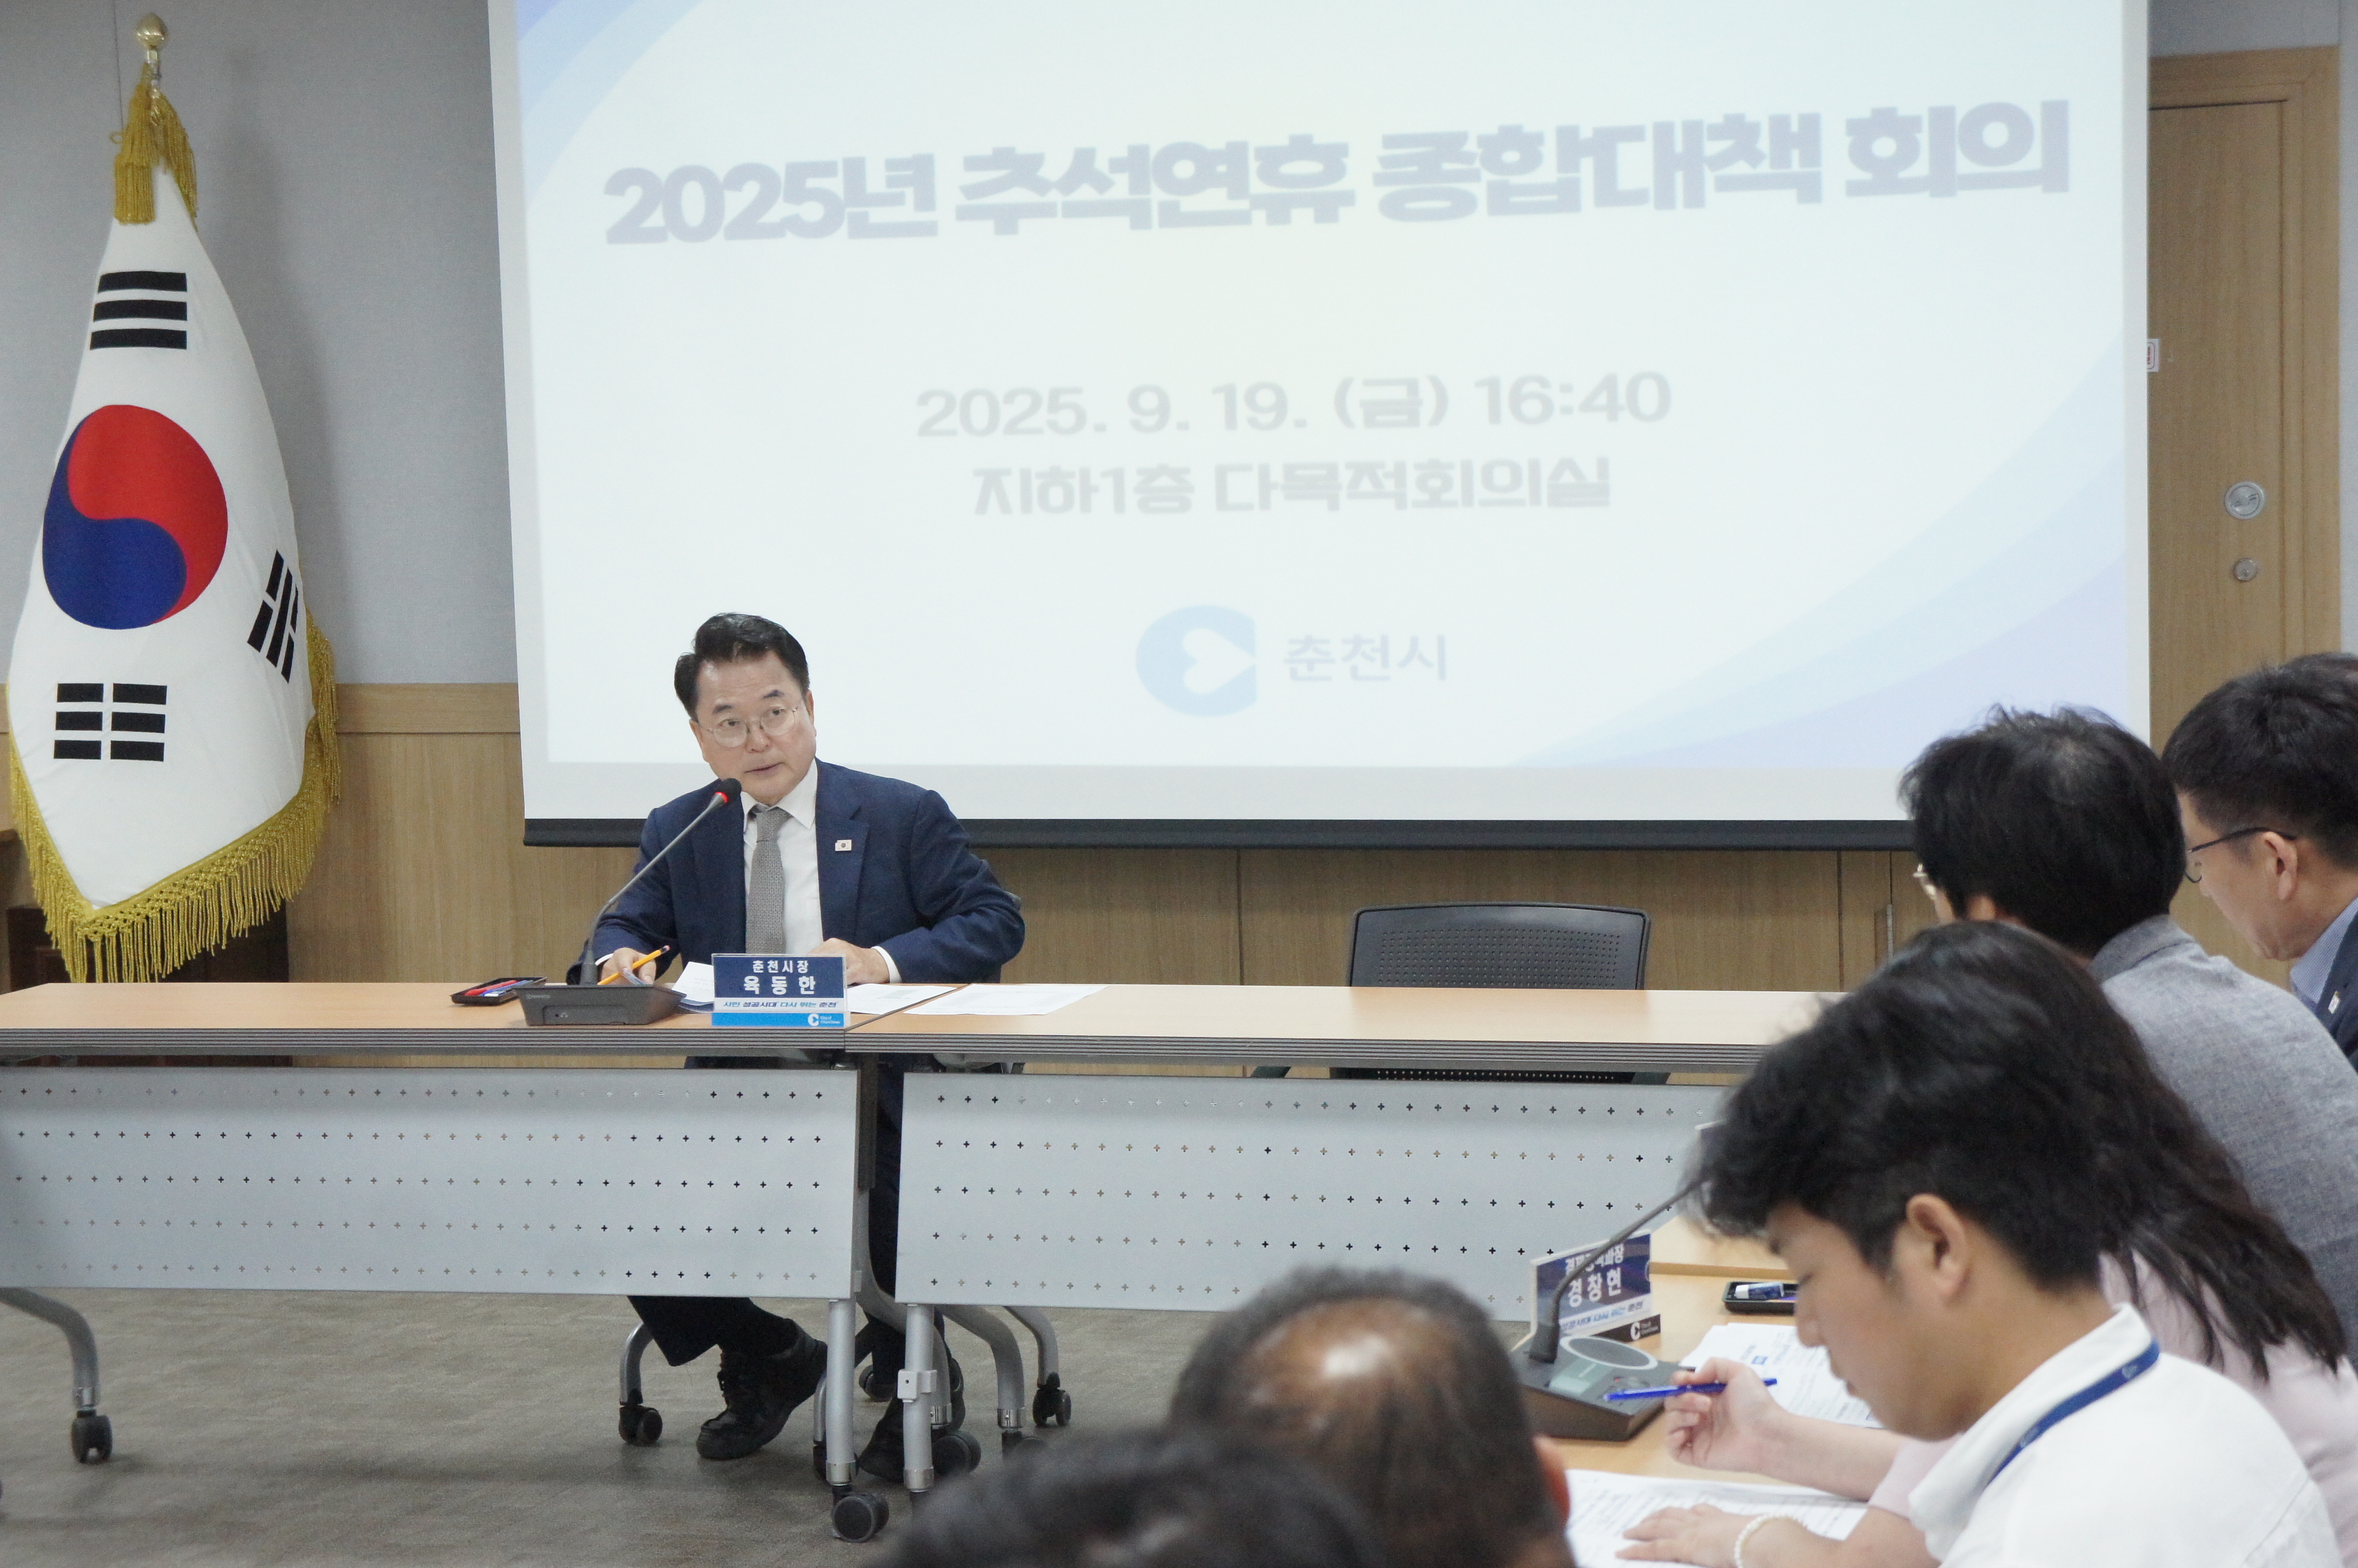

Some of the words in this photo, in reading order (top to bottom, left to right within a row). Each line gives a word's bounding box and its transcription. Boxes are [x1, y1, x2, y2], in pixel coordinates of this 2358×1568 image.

[604, 152, 938, 245] 2025년
[955, 134, 1355, 235] 추석연휴
[1373, 113, 1823, 222] 종합대책
[1845, 99, 2070, 198] 회의
[916, 387, 1107, 437] 2025.
[1127, 385, 1190, 434] 9.
[1211, 382, 1307, 431] 19.
[1333, 375, 1450, 429] (금)
[1474, 372, 1672, 425] 16:40
[972, 463, 1195, 515] 지하1층
[1214, 456, 1611, 512] 다목적회의실
[1283, 634, 1448, 682] 춘천시
[743, 975, 816, 995] 육동한
[752, 960, 809, 974] 춘천시장
[1568, 1267, 1622, 1308] 경창현
